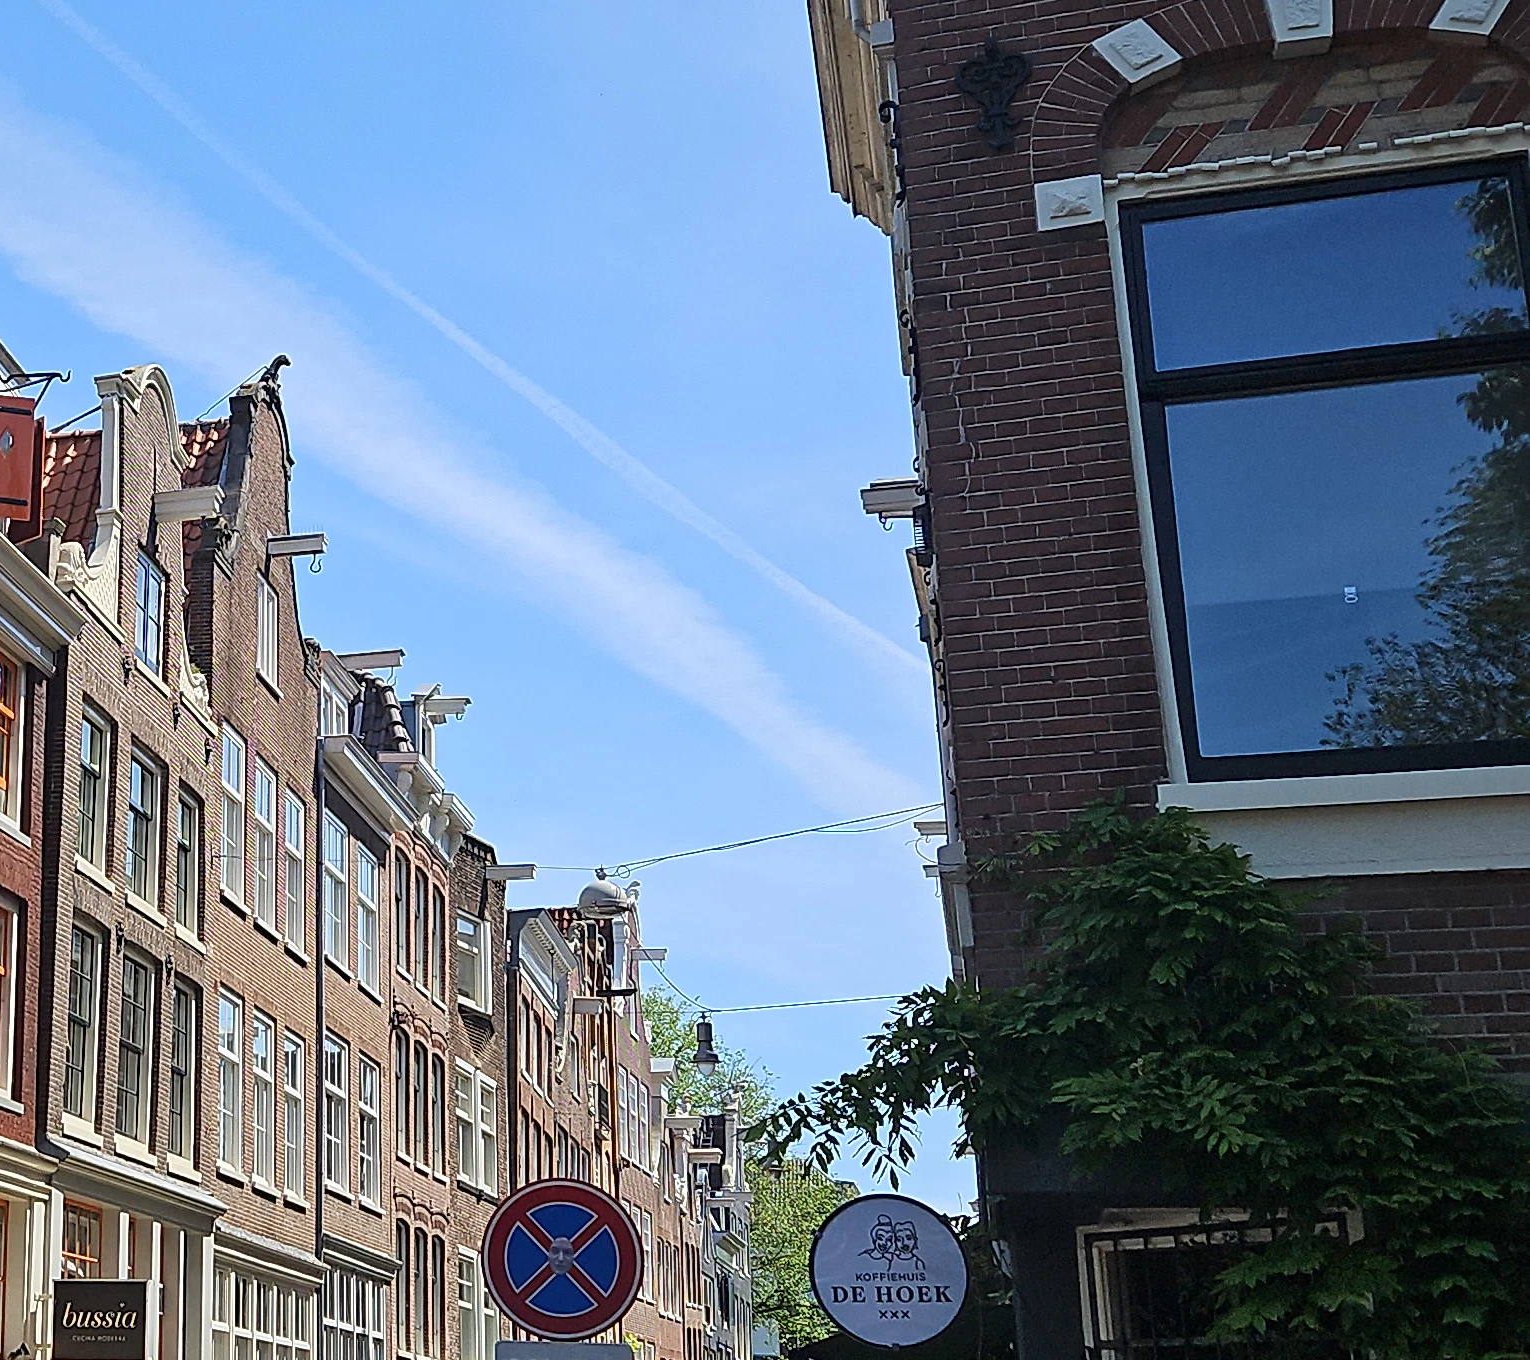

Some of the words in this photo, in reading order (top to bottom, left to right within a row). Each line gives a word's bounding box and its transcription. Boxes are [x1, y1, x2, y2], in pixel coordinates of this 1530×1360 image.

[855, 1272, 927, 1282] KOFFIEHUIS
[831, 1285, 866, 1303] DE
[875, 1285, 953, 1303] HOEK
[62, 1301, 137, 1328] bussia
